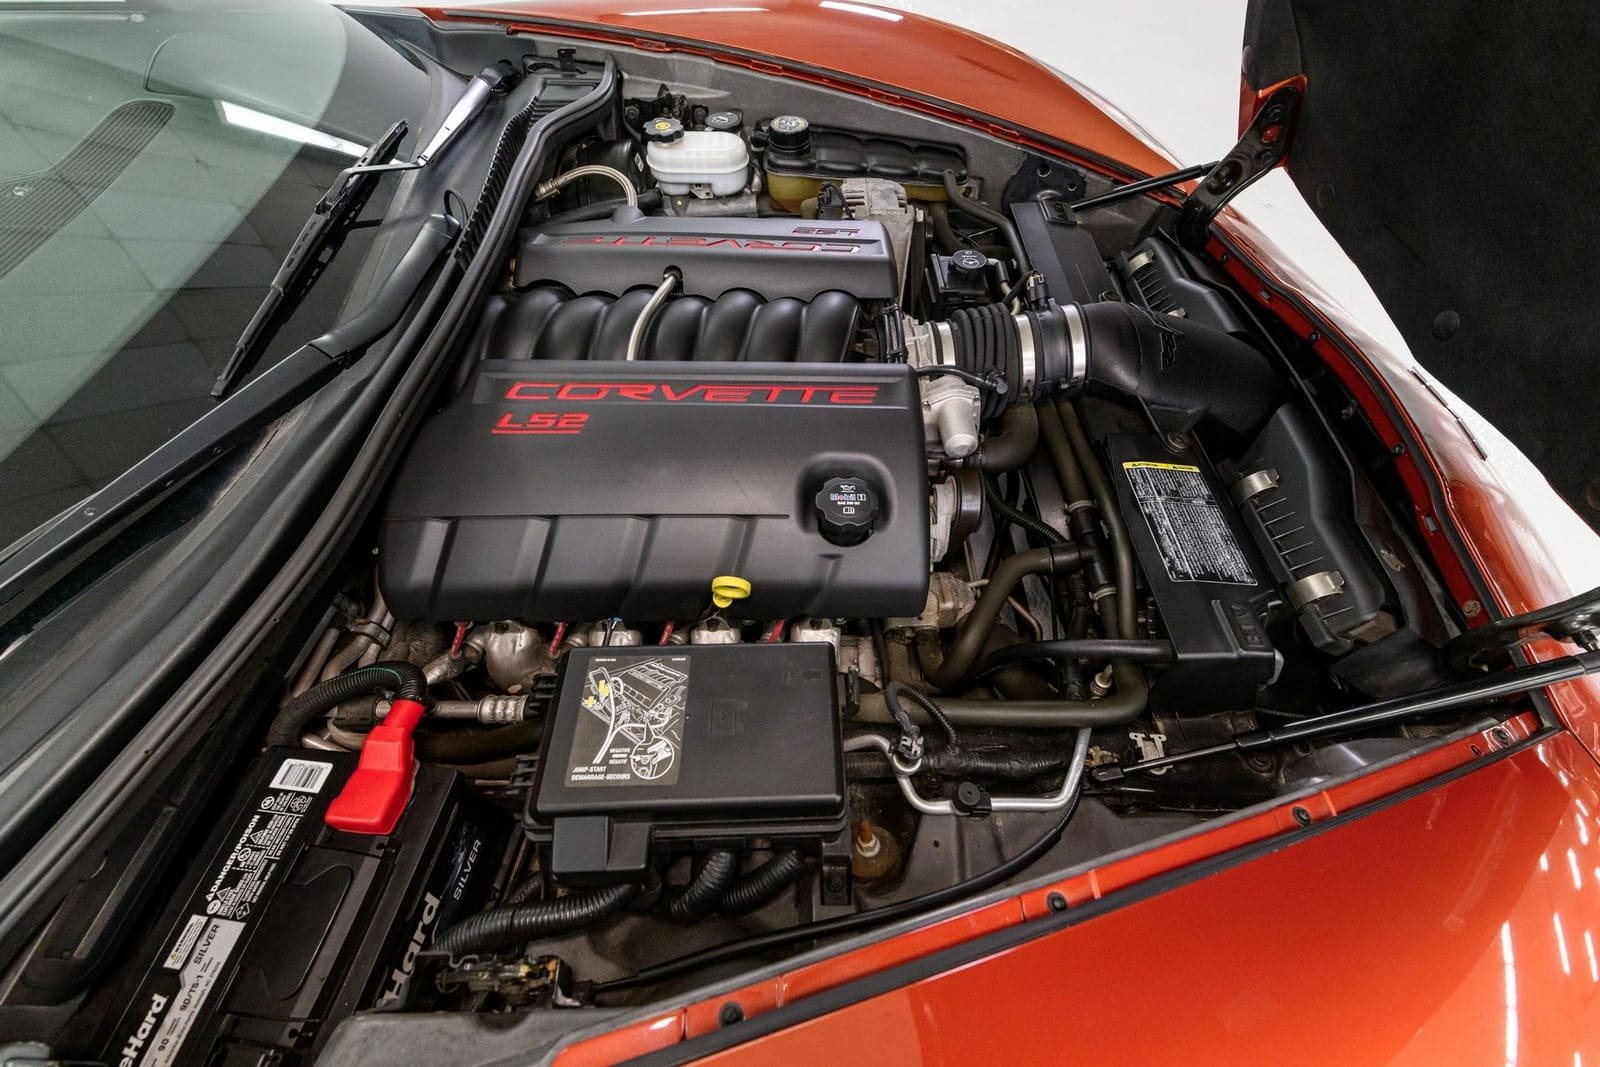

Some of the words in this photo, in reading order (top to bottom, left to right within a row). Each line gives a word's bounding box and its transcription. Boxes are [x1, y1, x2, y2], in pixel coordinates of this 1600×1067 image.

[560, 236, 861, 254] CORVETTE
[505, 382, 880, 404] CORVETTE
[495, 411, 591, 431] LS2
[830, 493, 856, 501] Mobil
[210, 814, 261, 893] DANGER/POISON
[453, 839, 482, 900] SILVER
[194, 924, 221, 965] SILVER
[158, 1038, 170, 1052] 90
